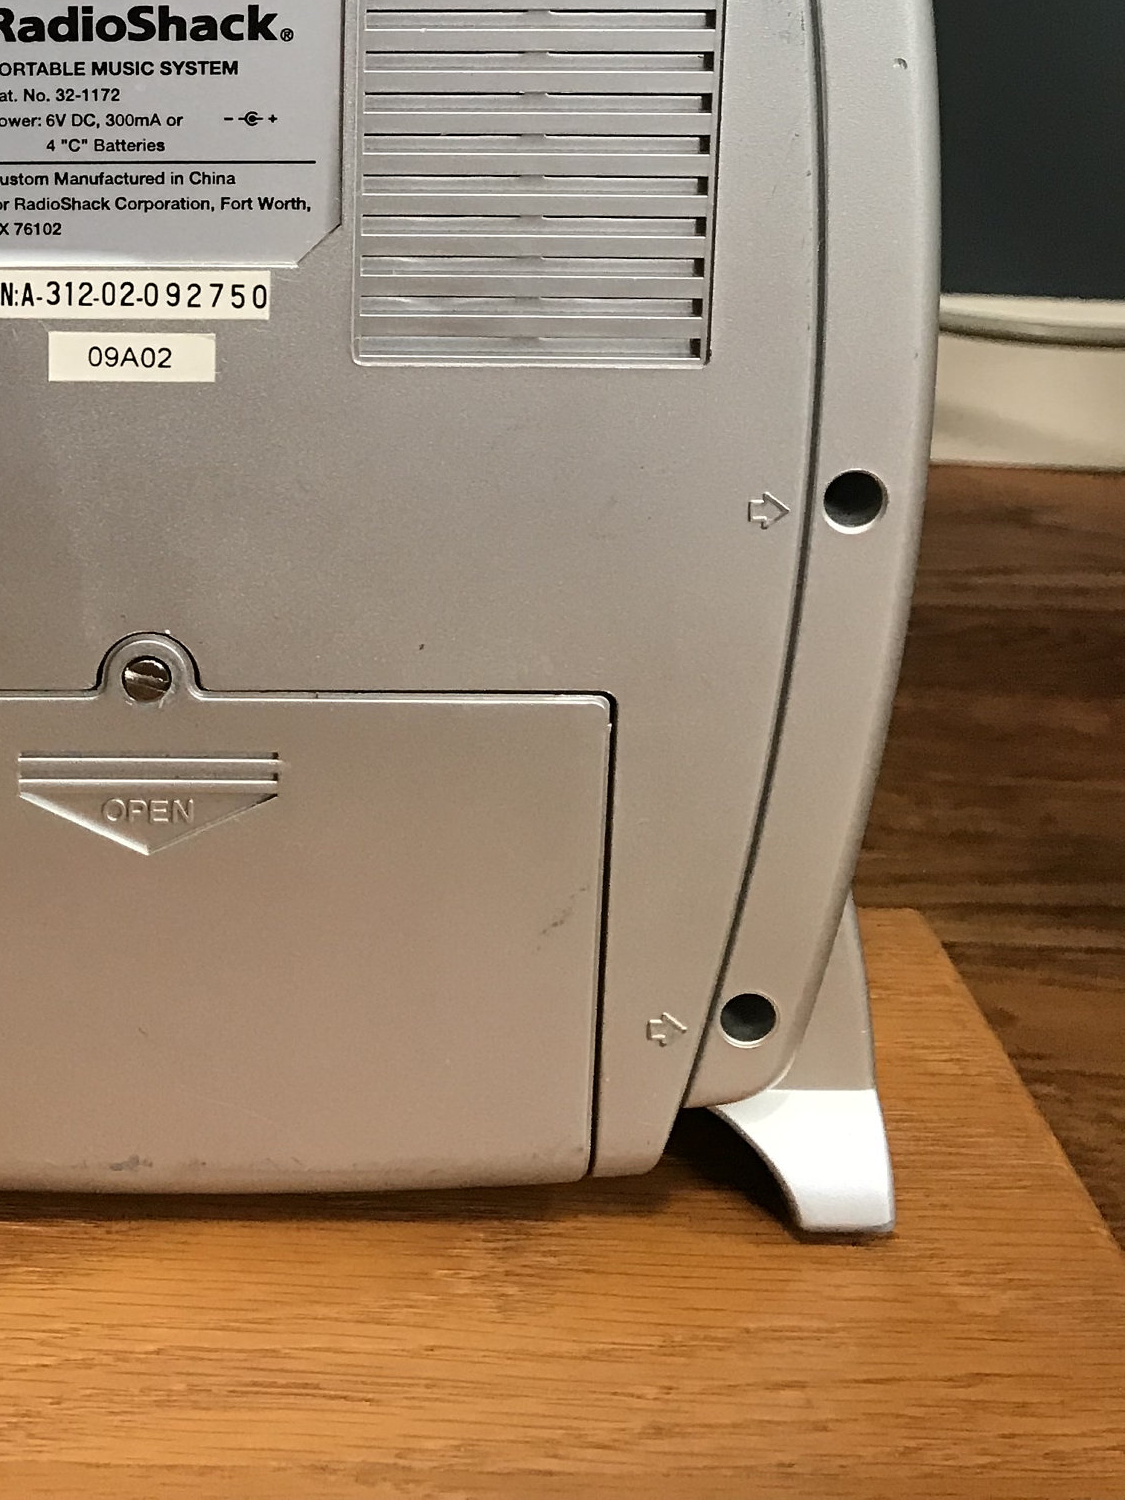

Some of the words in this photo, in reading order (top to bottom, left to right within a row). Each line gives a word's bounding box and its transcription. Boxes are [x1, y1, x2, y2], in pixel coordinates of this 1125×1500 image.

[91, 60, 155, 77] MUSIC
[159, 60, 239, 76] SYSTEM
[23, 88, 51, 103] No.
[55, 87, 120, 102] 32-1172
[45, 113, 67, 128] 6V
[71, 113, 101, 130] DC,
[105, 112, 162, 127] 300mA
[166, 115, 184, 127] or
[46, 139, 56, 152] 4
[60, 138, 88, 153] "C"
[93, 138, 166, 153] Batteries
[54, 171, 165, 186] Manufactured
[170, 171, 184, 186] in
[188, 170, 236, 186] China
[14, 196, 111, 211] RadioShack
[114, 196, 215, 214] Corporation,
[220, 196, 254, 211] Fort
[257, 196, 311, 213] Worth,
[13, 222, 62, 236] 76102
[88, 345, 172, 369] 09A02
[102, 798, 194, 823] OPEN
